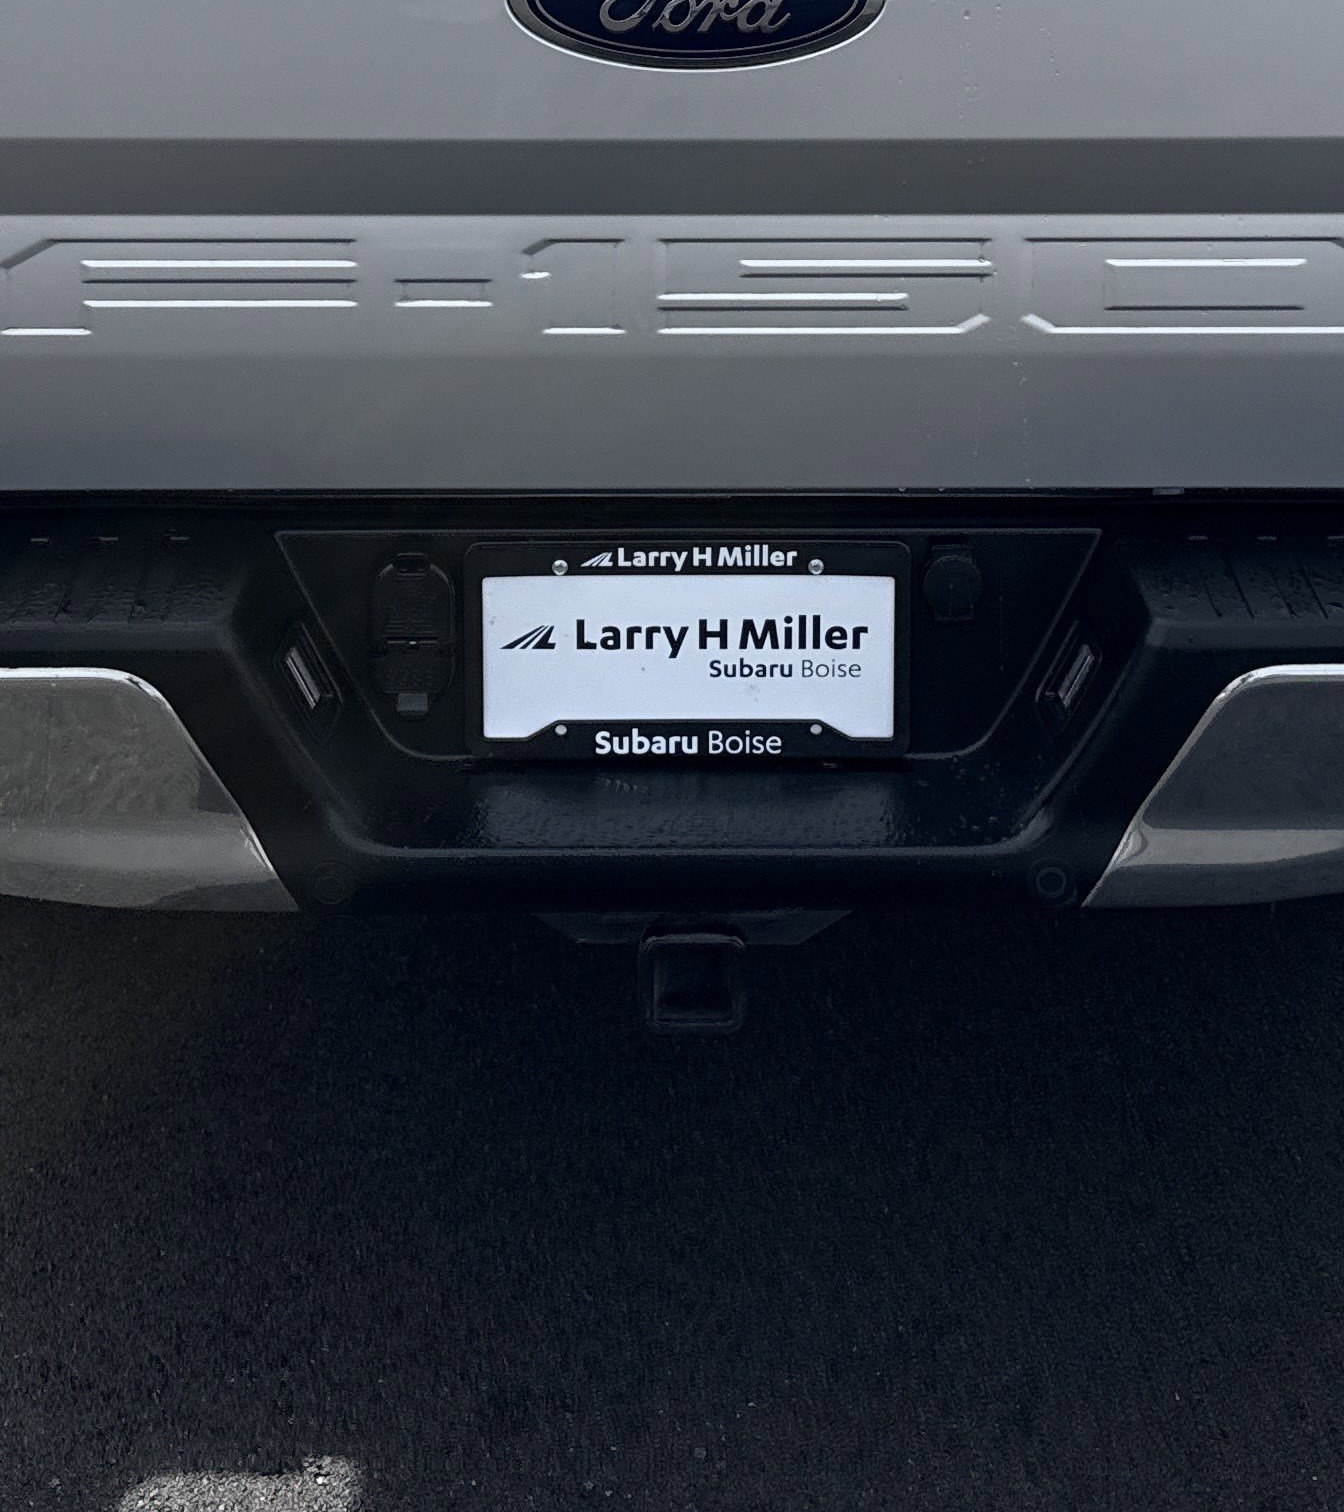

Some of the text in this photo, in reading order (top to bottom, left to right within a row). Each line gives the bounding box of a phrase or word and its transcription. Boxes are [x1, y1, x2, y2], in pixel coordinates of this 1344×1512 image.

[617, 544, 798, 571] Larry H Miller
[576, 615, 868, 658] Larry H Miller
[709, 658, 862, 678] Subaru Boise
[595, 728, 782, 754] Subaru Boise
